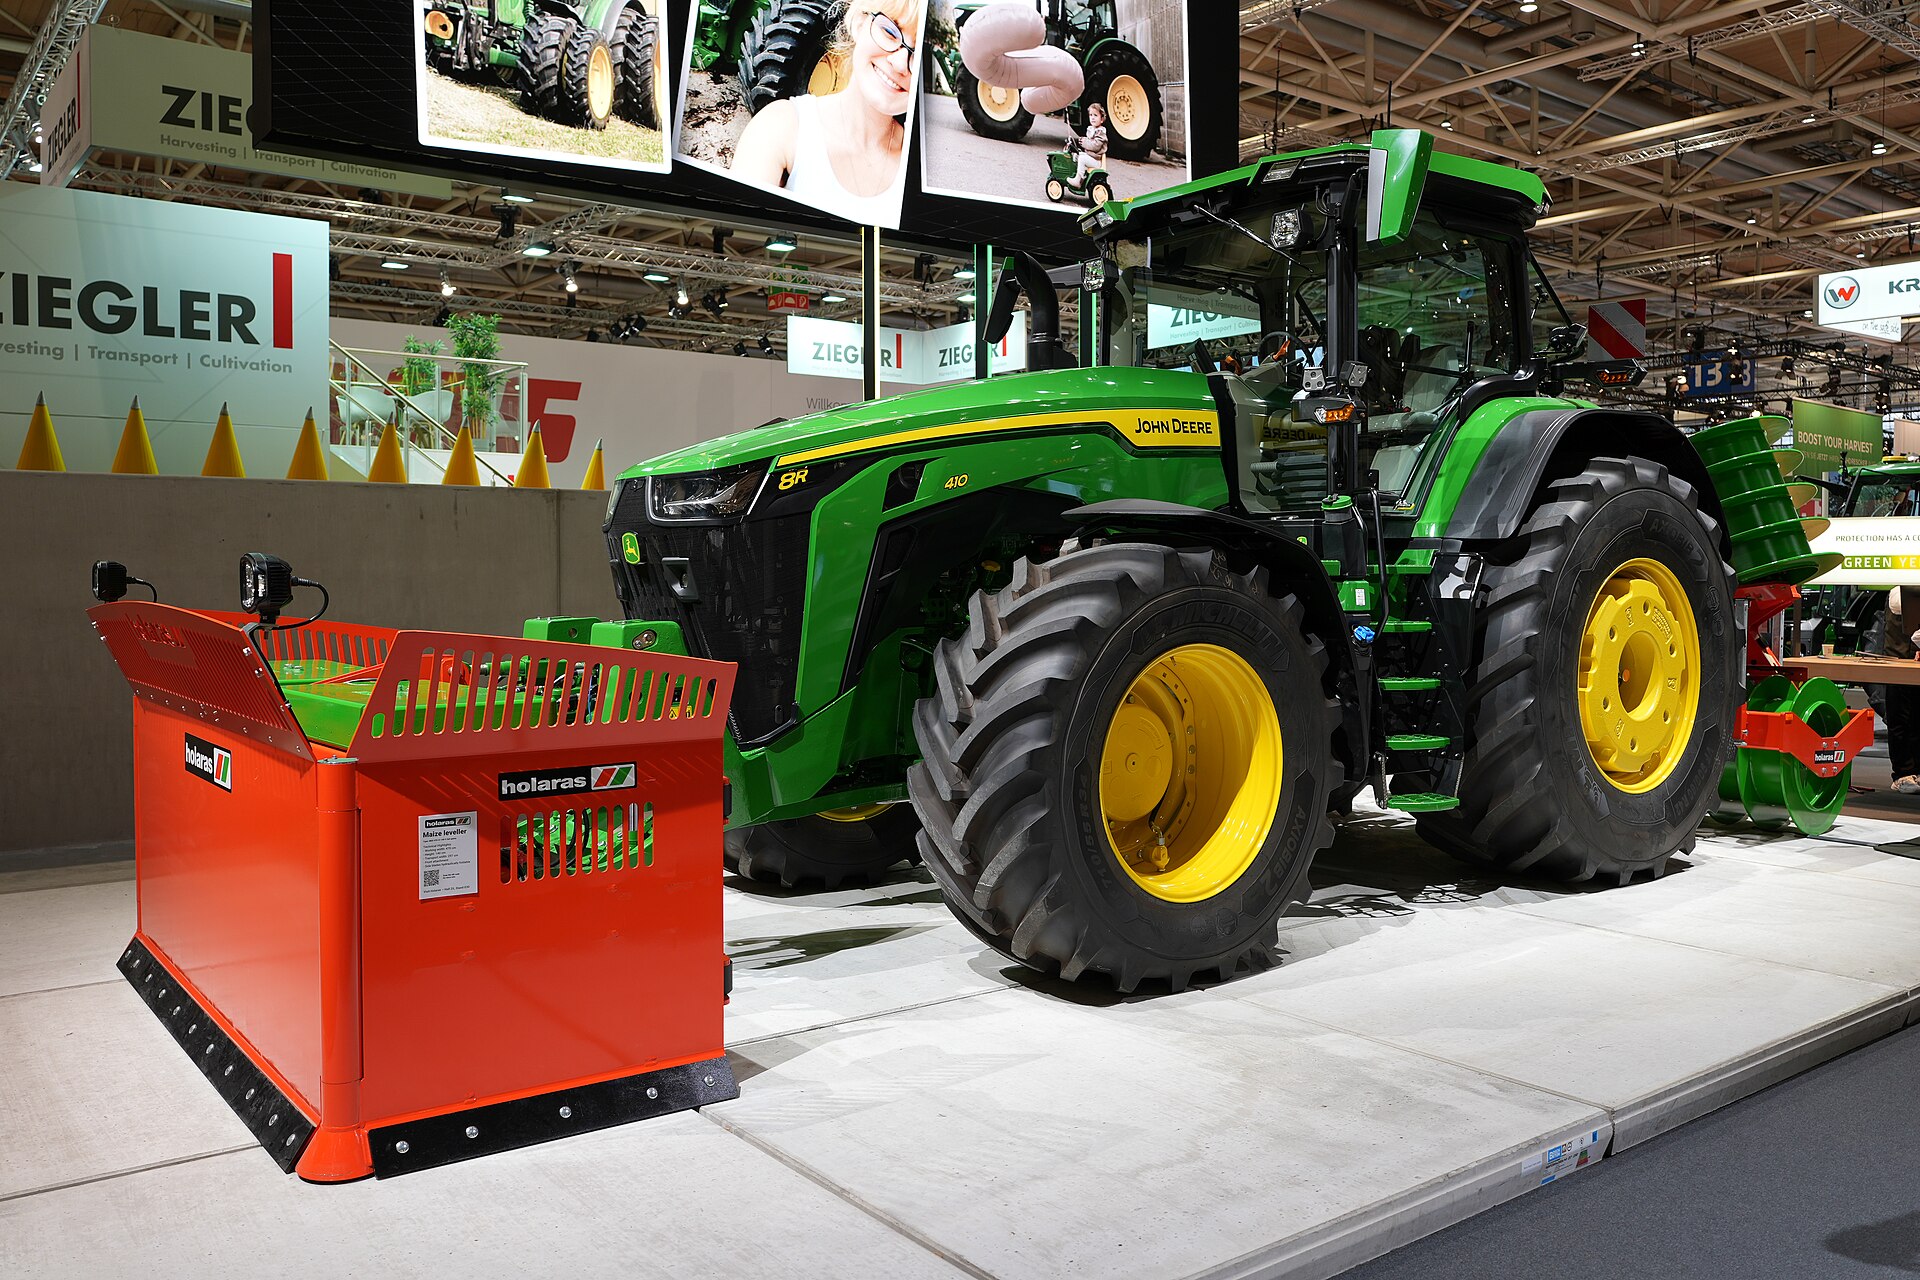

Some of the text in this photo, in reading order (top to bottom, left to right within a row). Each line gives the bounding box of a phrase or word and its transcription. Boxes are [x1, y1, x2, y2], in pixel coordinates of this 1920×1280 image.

[159, 84, 253, 137] ZIE
[47, 97, 76, 173] ZIEGLER
[160, 134, 397, 180] Harvesting Transport Cultivation
[88, 345, 178, 366] Transport
[199, 354, 293, 374] Cultivation
[812, 341, 893, 368] ZIEGR
[938, 343, 999, 368] ZIEGR
[1135, 417, 1213, 435] JOHN DEERE
[1797, 431, 1873, 454] BOOST YOUR HARVEST
[778, 467, 809, 491] 8R
[943, 474, 968, 490] 410
[1844, 557, 1892, 568] GREEN
[185, 742, 213, 774] holaras
[502, 776, 587, 795] holaras
[422, 830, 442, 838] Maize
